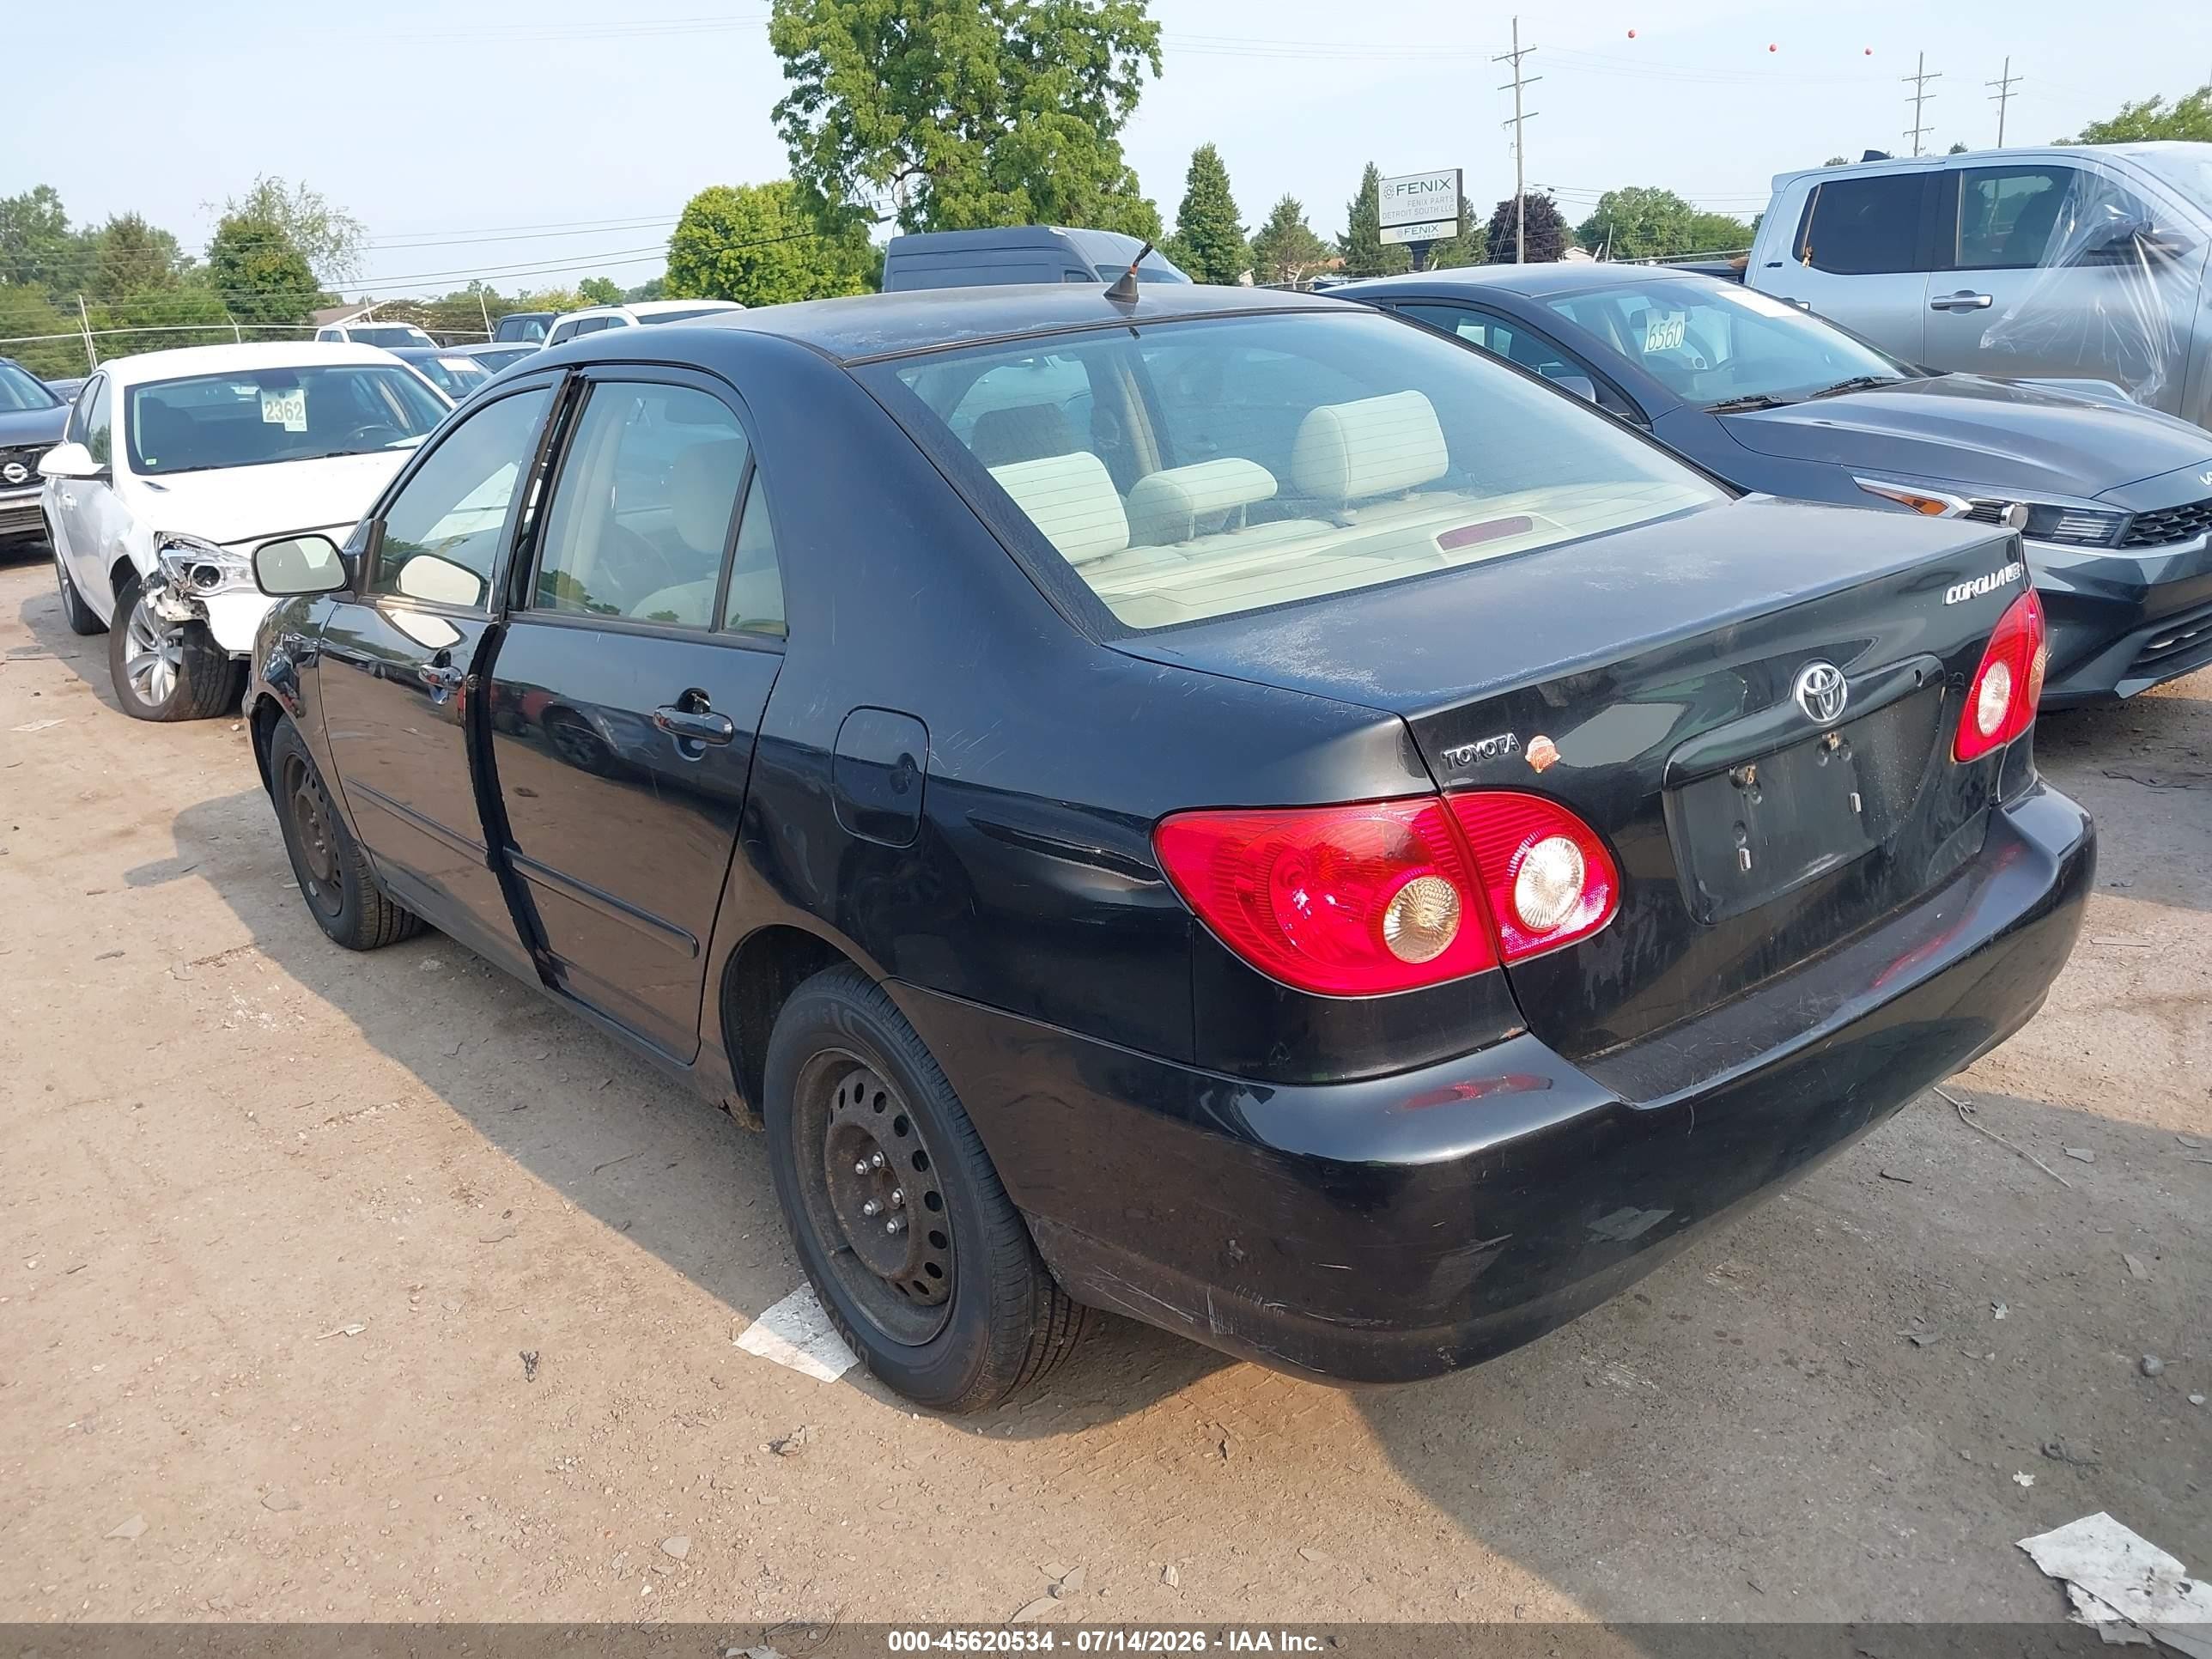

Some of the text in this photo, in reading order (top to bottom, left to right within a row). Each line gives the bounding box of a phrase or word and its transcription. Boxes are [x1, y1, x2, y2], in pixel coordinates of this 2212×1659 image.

[1396, 177, 1452, 197] FENIX
[1382, 204, 1455, 220] DETROIT SOUTH LLC
[1407, 195, 1455, 208] FENIX PARTS
[1404, 223, 1439, 236] FENIX
[1648, 321, 1683, 351] 6560
[264, 400, 304, 422] 2362
[1942, 568, 2006, 605] COROLLA
[1441, 732, 1521, 770] TOYOTA
